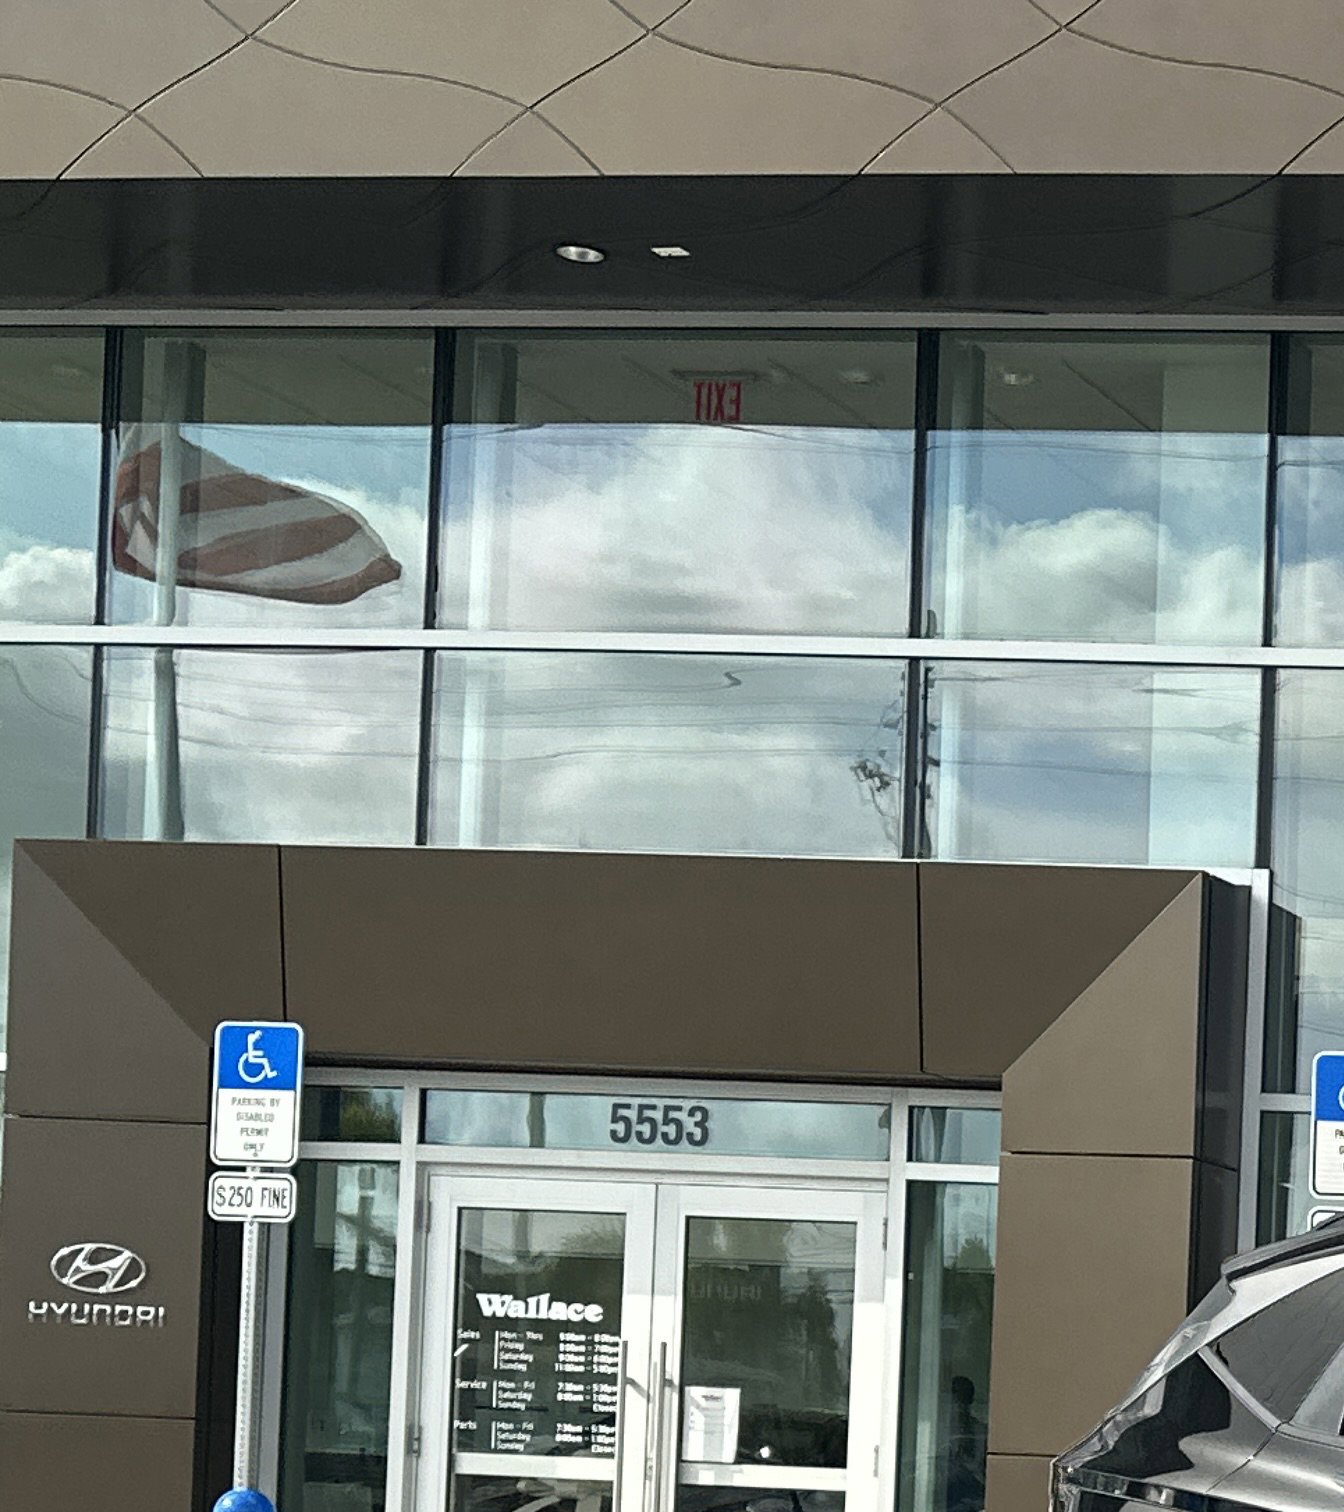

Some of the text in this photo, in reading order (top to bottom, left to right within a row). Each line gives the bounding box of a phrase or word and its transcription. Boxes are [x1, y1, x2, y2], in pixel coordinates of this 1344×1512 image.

[609, 1102, 710, 1147] 5553
[215, 1184, 288, 1209] $250 FINE
[28, 1300, 166, 1328] HYUNDAI
[475, 1292, 604, 1323] Wallace
